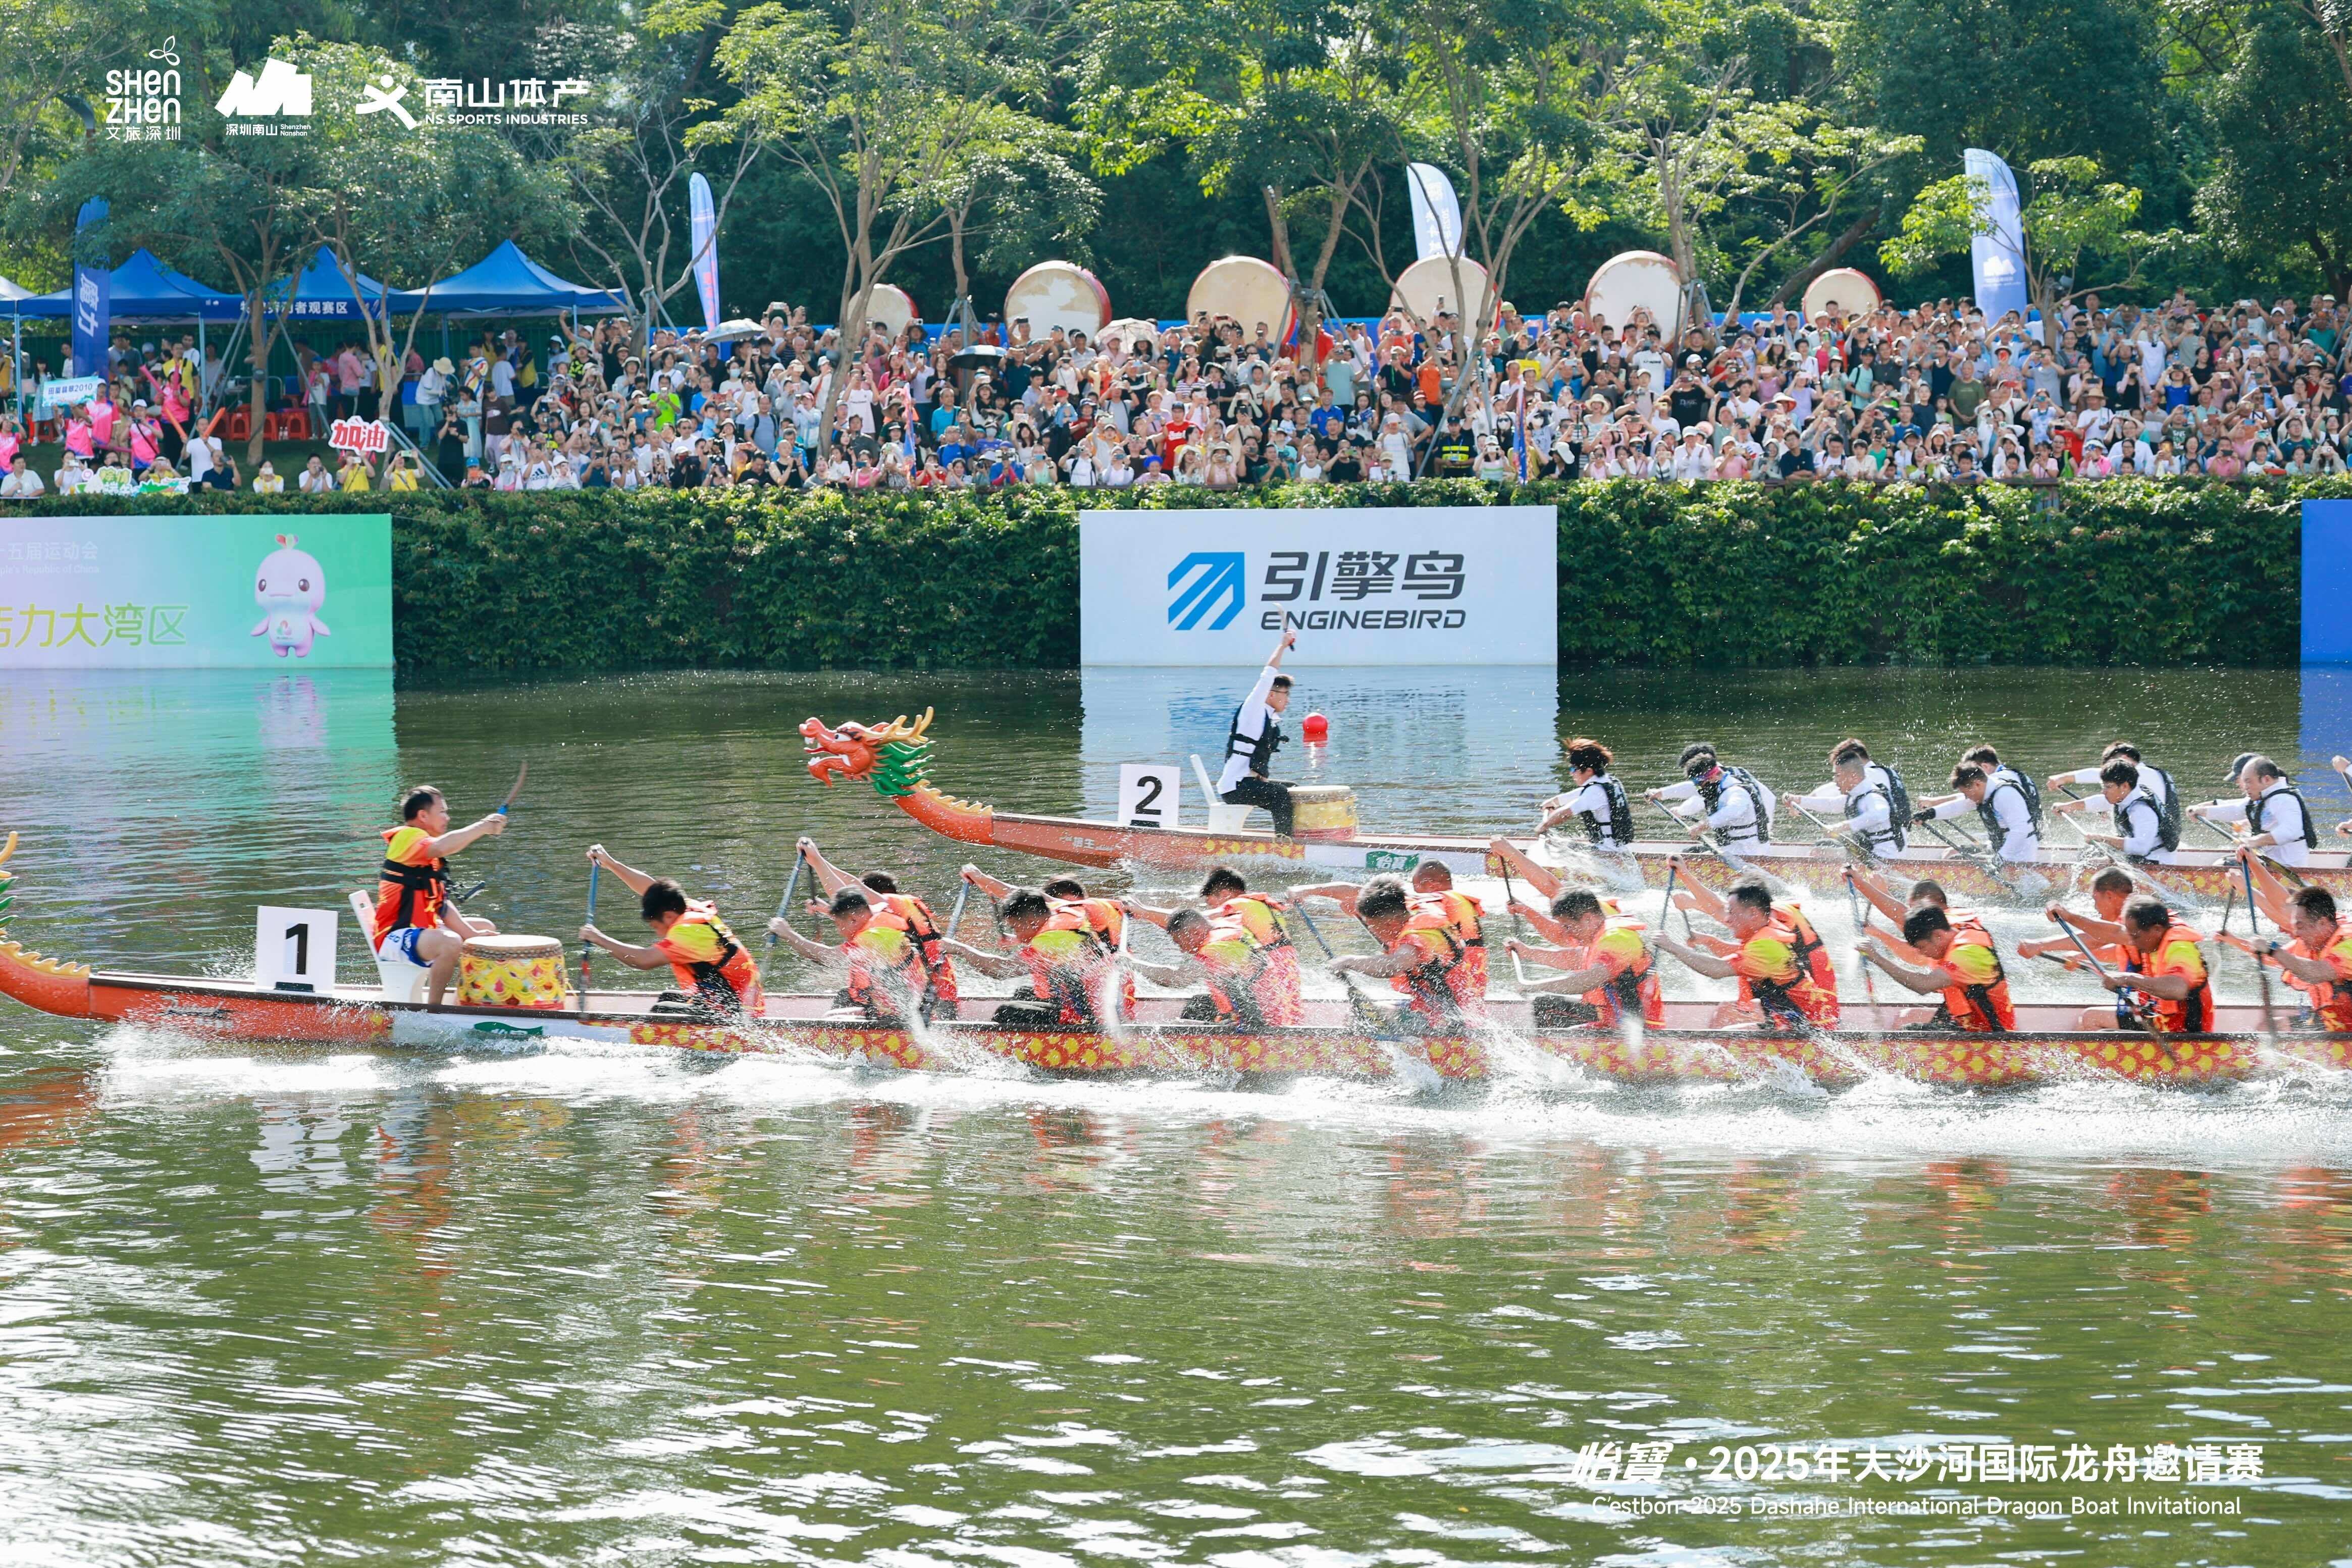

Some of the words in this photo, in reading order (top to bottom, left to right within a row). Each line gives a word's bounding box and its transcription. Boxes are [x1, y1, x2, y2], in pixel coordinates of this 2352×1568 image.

[332, 423, 385, 450] 加油
[0, 541, 99, 561] 五届运动会
[1261, 551, 1466, 602] 引擎鸟
[1261, 610, 1466, 630] ENGINEBIRD
[1135, 776, 1162, 815] 2
[286, 923, 308, 975] 1
